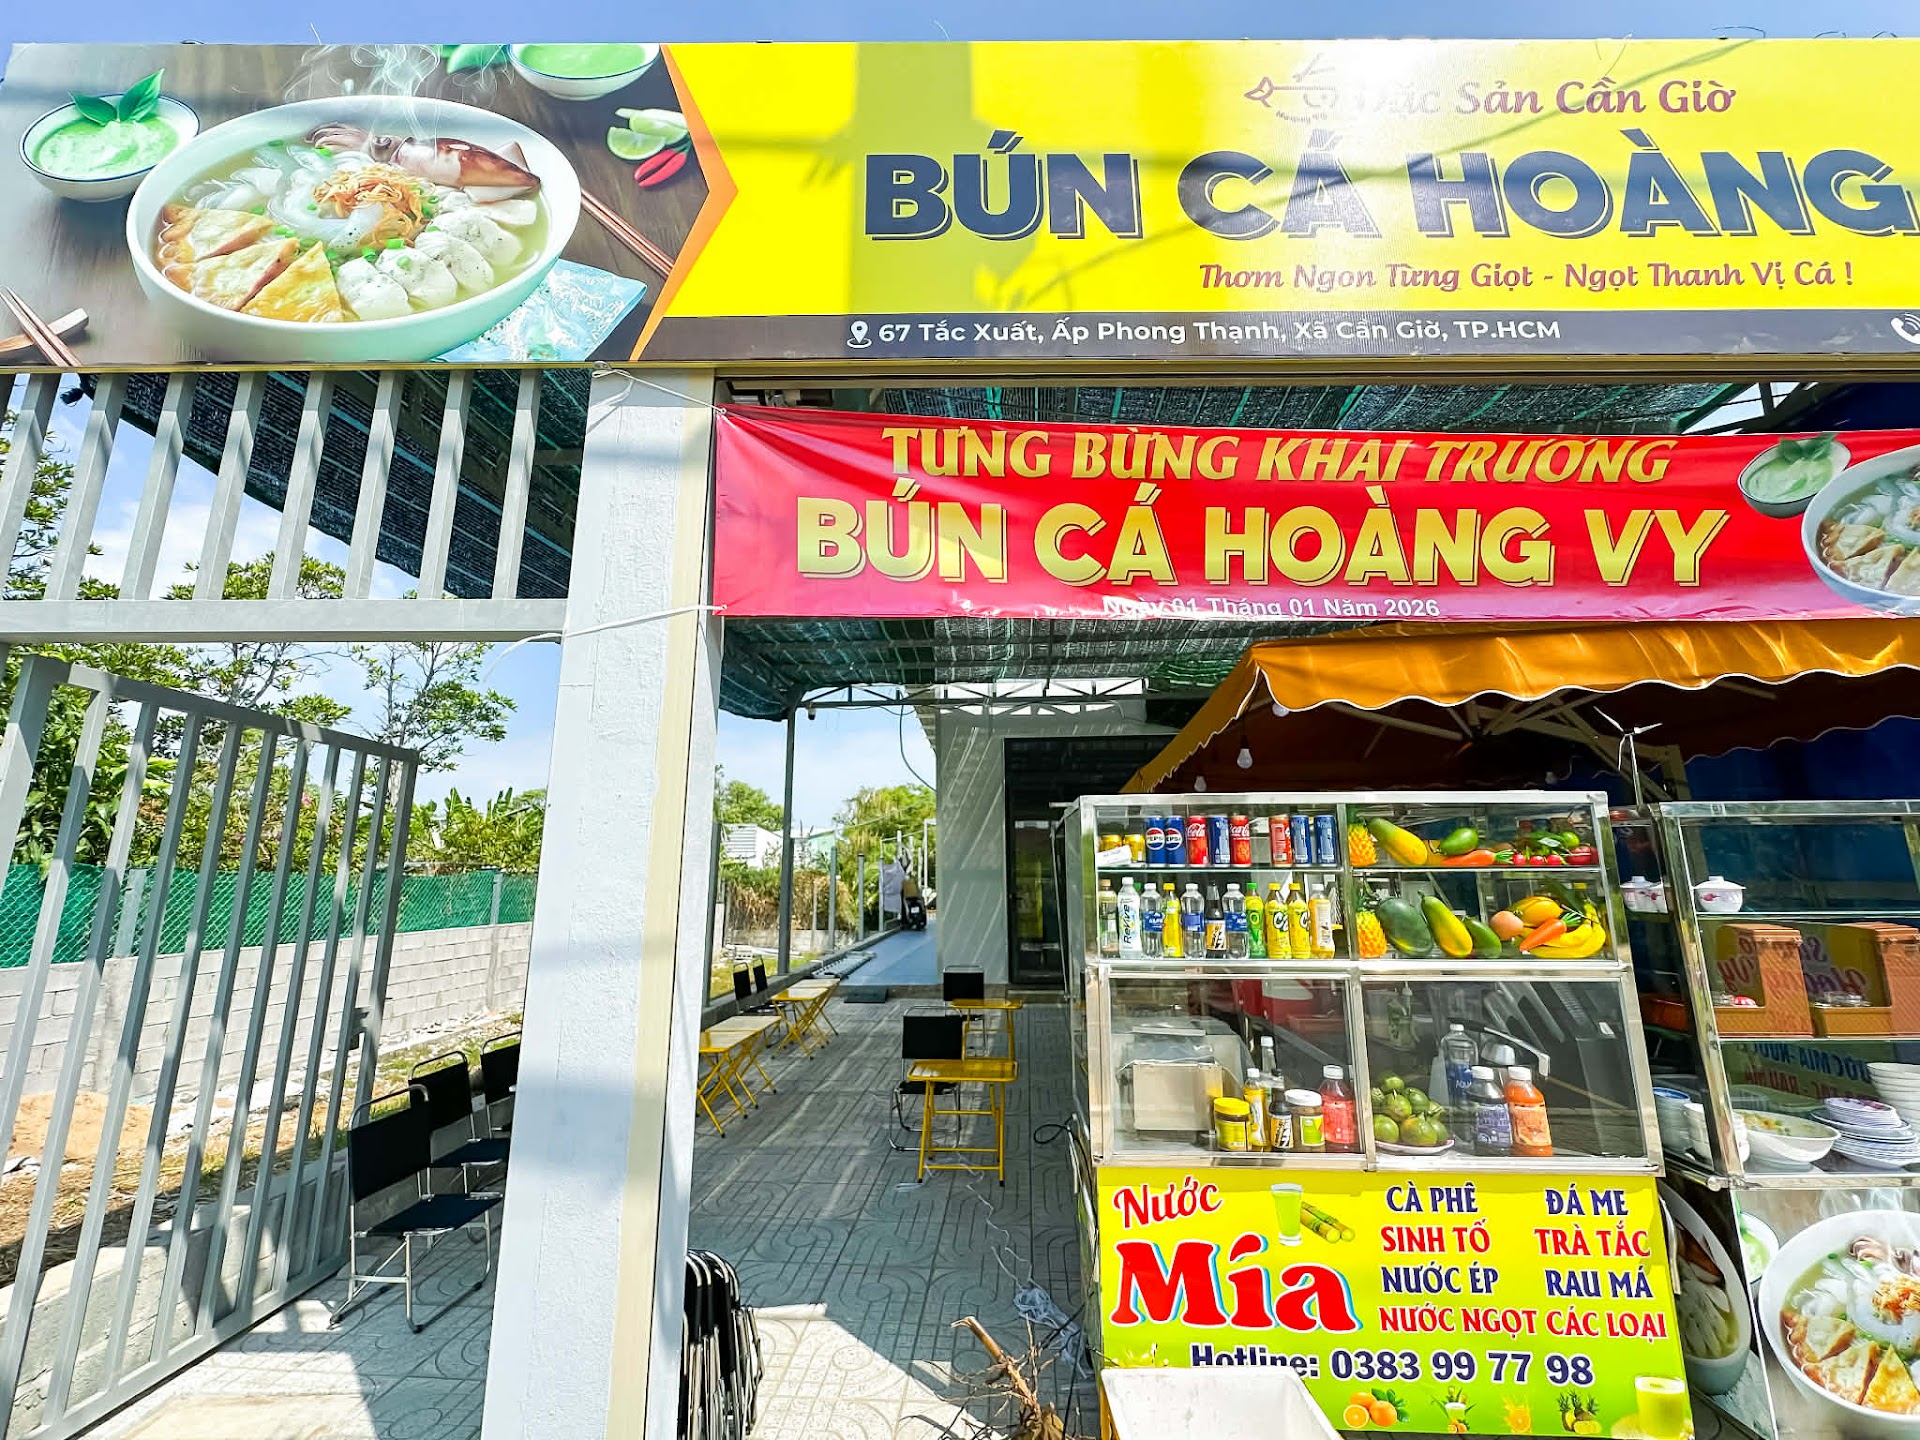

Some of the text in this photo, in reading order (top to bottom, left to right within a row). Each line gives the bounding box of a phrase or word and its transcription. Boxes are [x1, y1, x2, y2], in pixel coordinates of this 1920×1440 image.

[1455, 80, 1543, 115] Sản
[1555, 75, 1646, 114] Cần
[1658, 79, 1736, 114] Giờ
[865, 128, 1920, 241] BÚN CÁ HOÀNG
[1200, 263, 1284, 289] Thơm
[1293, 263, 1377, 293] Ngon
[1385, 262, 1460, 293] Từng
[1471, 262, 1534, 292] Giọt
[1565, 263, 1639, 292] Ngọt
[1648, 261, 1745, 287] Thanh
[1751, 261, 1786, 291] Vị
[1794, 261, 1836, 286] Cá
[878, 317, 1561, 346] 67 Tắc Xuất, Ấp Phong Thạnh, Xã Cần Giờ, TP.HCM
[882, 426, 1680, 483] TƯNG BỪNG KHAI TRƯƠNG
[797, 477, 1731, 588] BÚN CÁ HOÀNG VY
[1206, 597, 1283, 616] Tháng
[1288, 598, 1316, 616] 01
[1323, 598, 1378, 617] Năm
[1384, 599, 1441, 617] 2026
[1113, 1176, 1222, 1228] Nước
[1386, 1182, 1478, 1213] CÀ PHÊ
[1545, 1183, 1629, 1216] ĐÁ ME
[1380, 1218, 1491, 1253] SINH TỐ
[1534, 1220, 1651, 1257] TRÀ TẮC
[1110, 1233, 1363, 1331] Mía
[1381, 1261, 1499, 1294] NƯỚC ÉP
[1545, 1265, 1654, 1299] RAU MÁ
[1379, 1303, 1668, 1343] NƯỚC NGỌT CÁC LOẠI
[1191, 1344, 1594, 1385] Hotline: 0383 99 77 98
